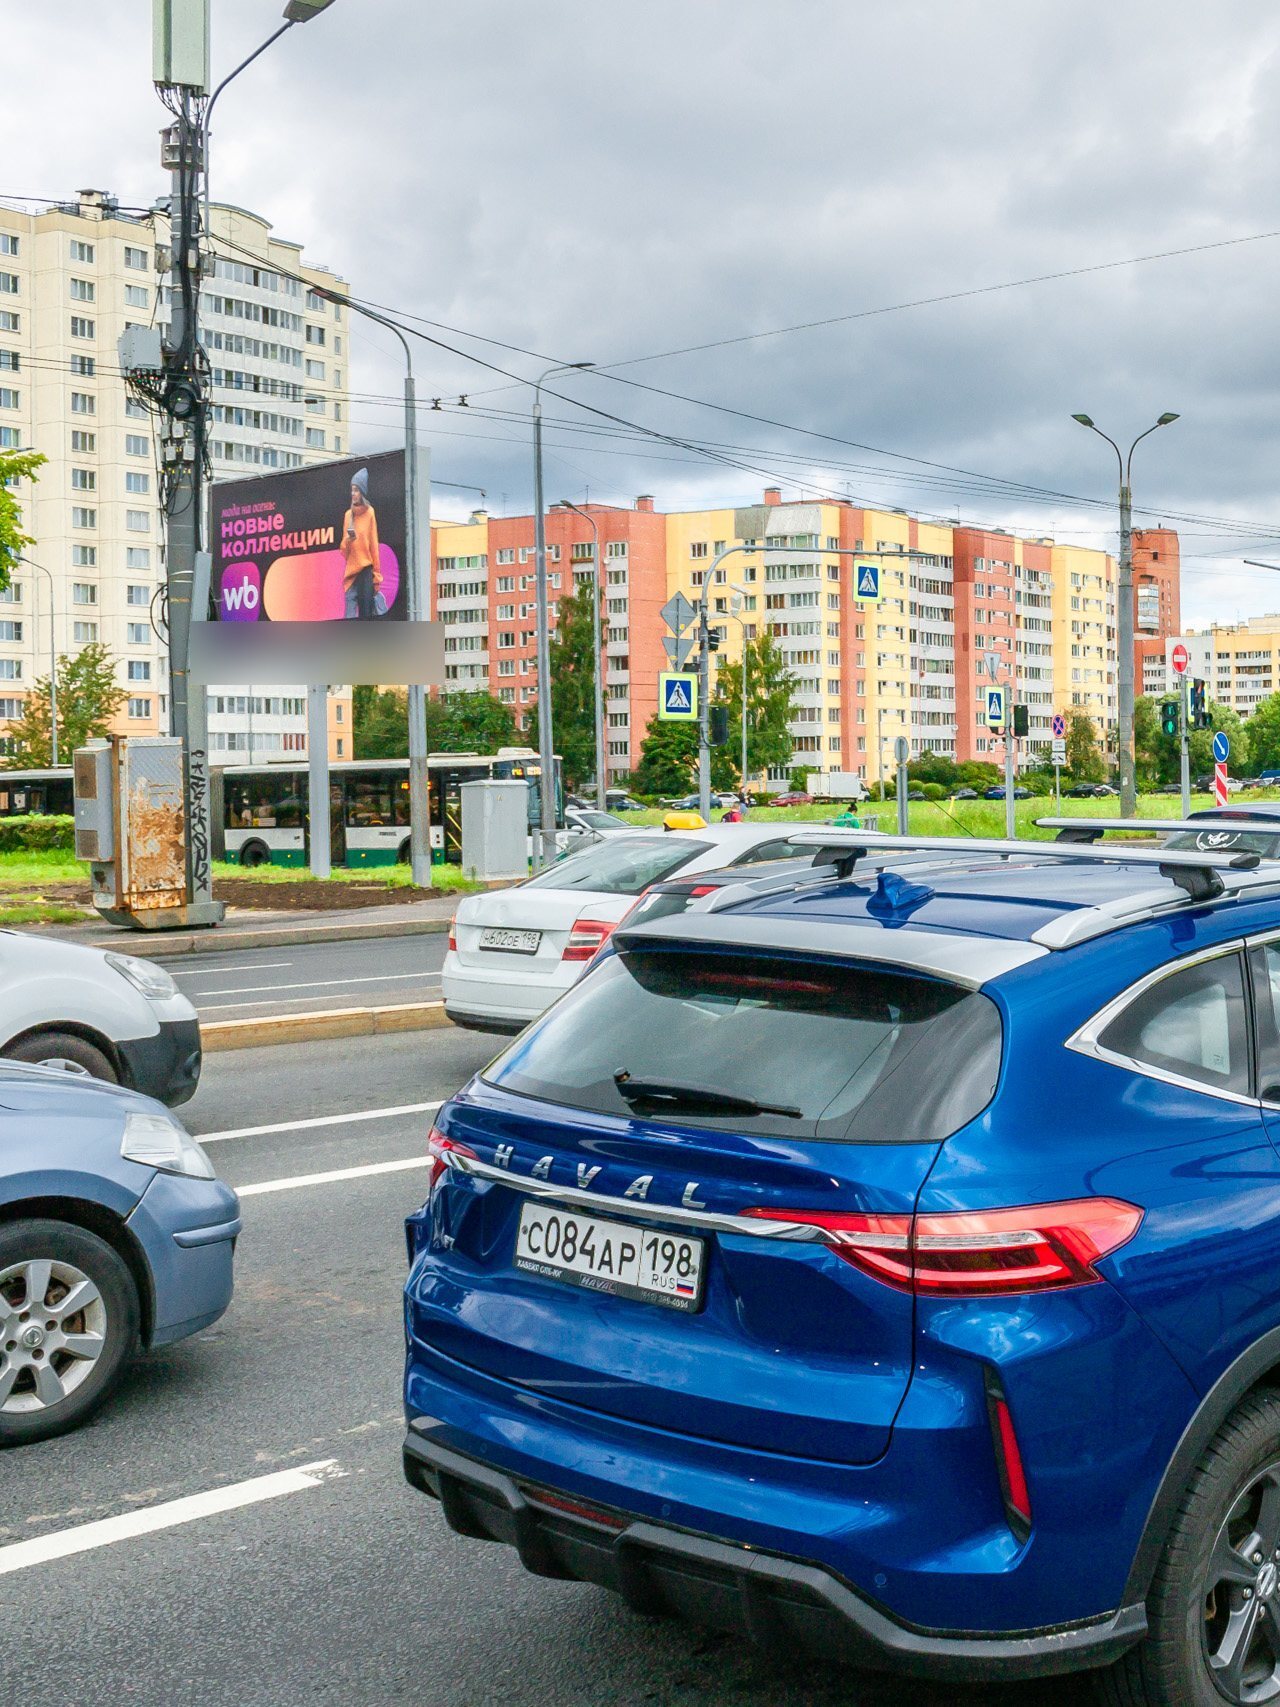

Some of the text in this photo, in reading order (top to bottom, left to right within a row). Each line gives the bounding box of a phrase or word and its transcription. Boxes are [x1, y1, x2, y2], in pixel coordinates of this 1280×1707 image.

[221, 513, 285, 539] новые
[221, 526, 335, 559] коллекции
[223, 575, 259, 611] wb
[493, 1143, 706, 1210] HAVAL
[527, 1216, 693, 1278] С084АР 198
[651, 1273, 676, 1291] RUS
